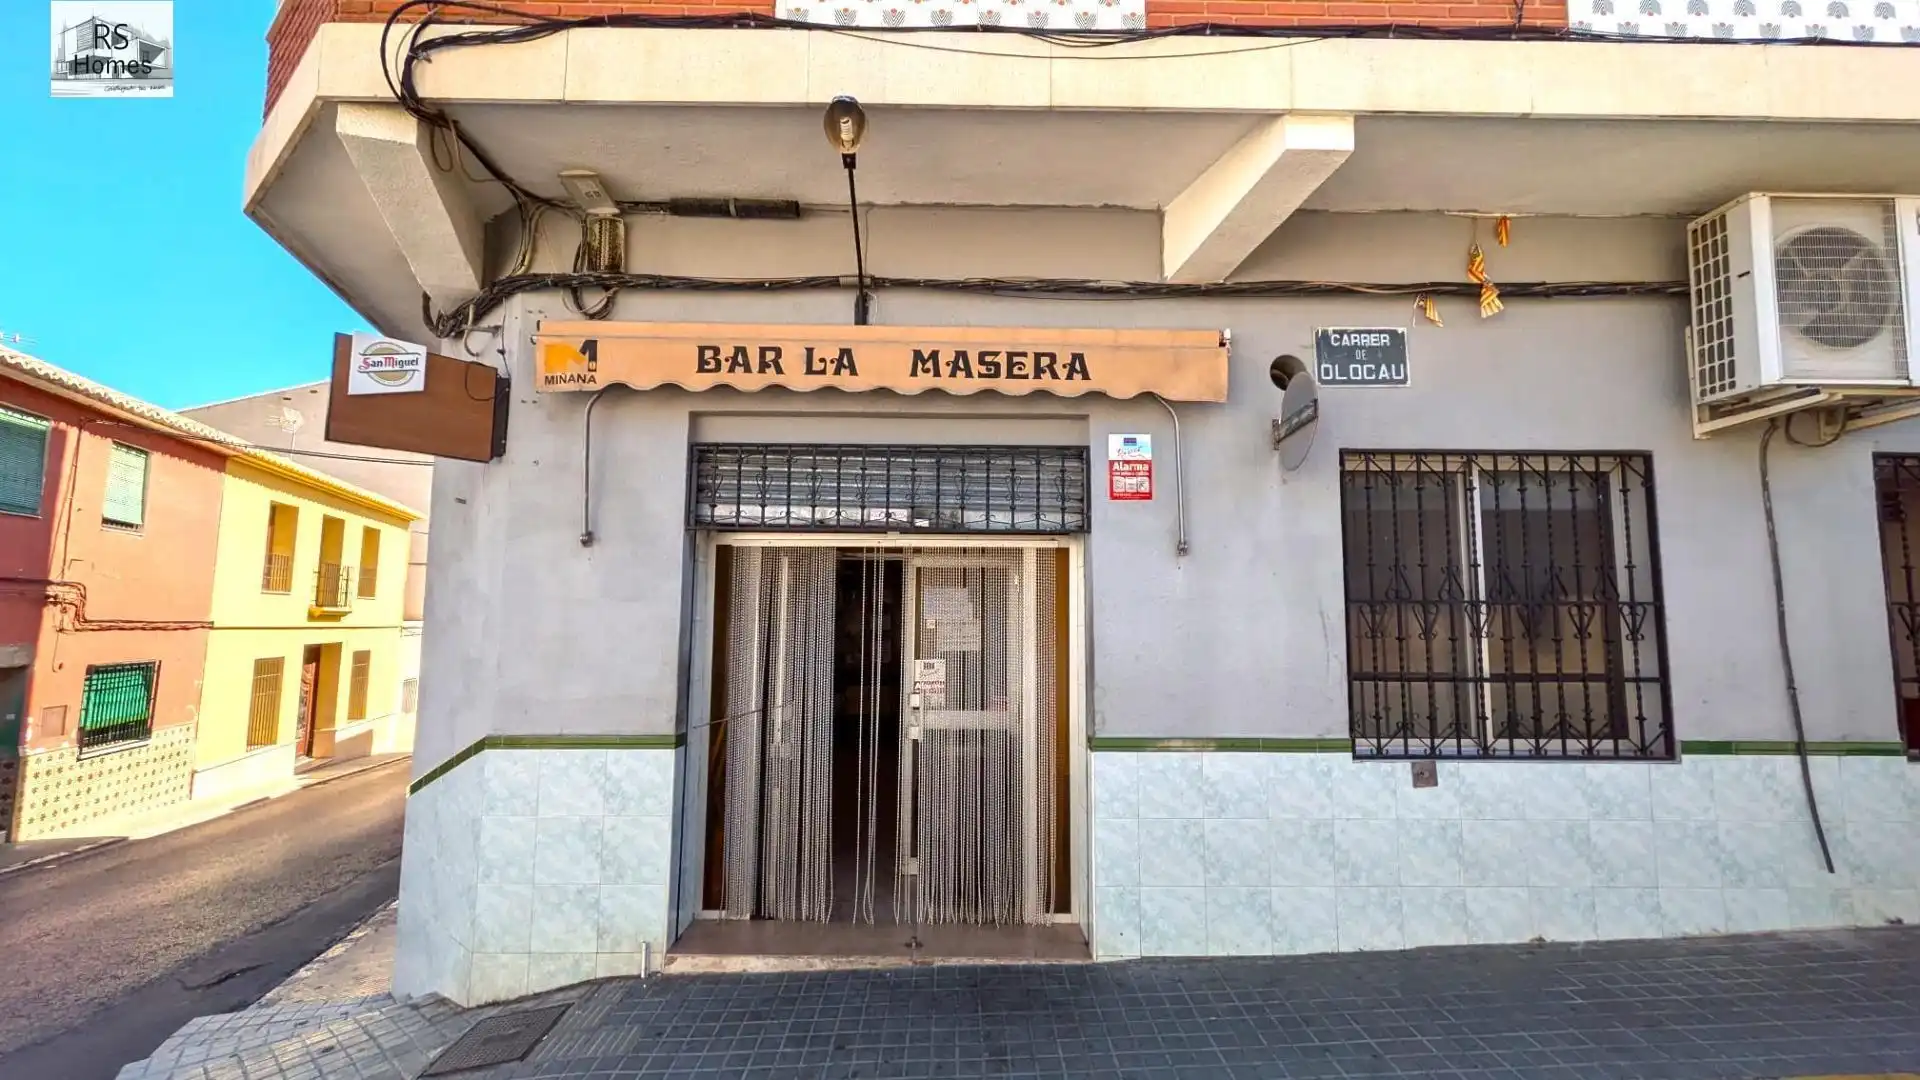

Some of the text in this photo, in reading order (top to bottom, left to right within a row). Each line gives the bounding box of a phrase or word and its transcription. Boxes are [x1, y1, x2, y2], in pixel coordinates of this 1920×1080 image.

[1330, 333, 1391, 347] CARRER
[1355, 349, 1367, 360] DE
[696, 344, 1092, 381] BAR LA MASERA
[544, 371, 597, 385] MIÑANA
[1320, 363, 1405, 380] OLOCAU
[1112, 460, 1149, 471] Alarma
